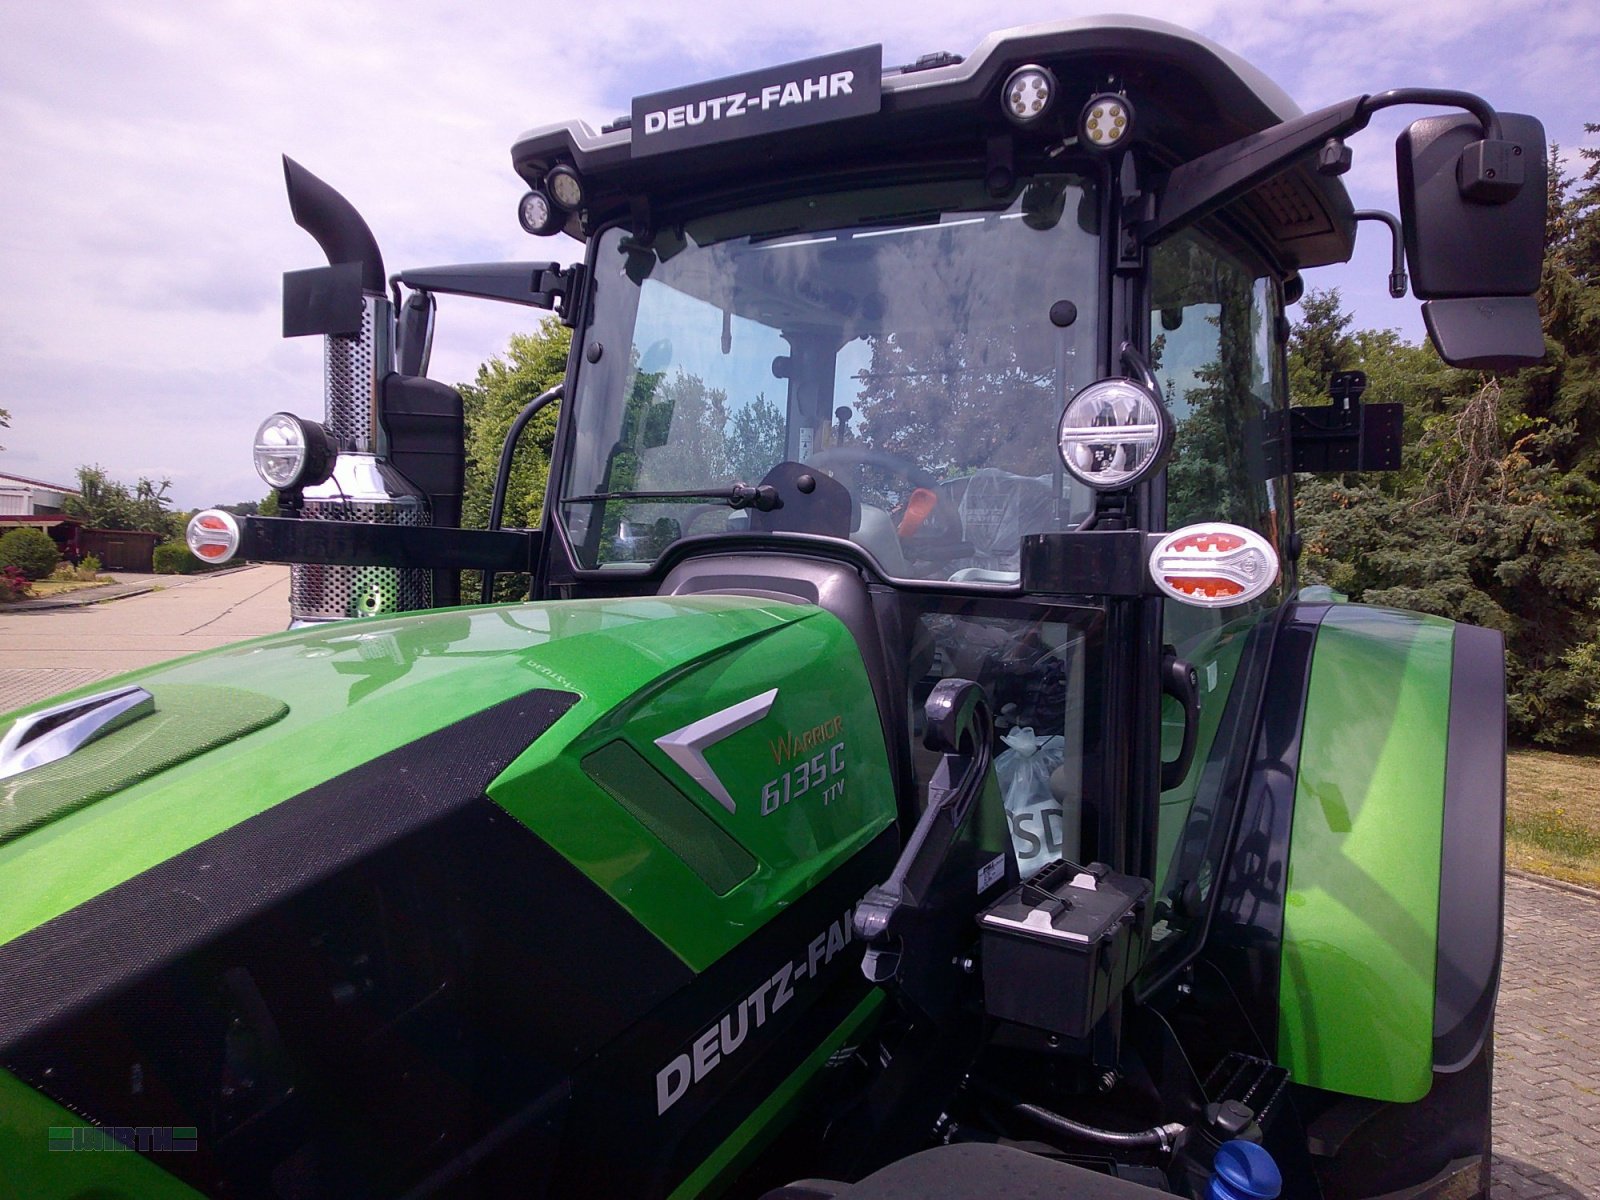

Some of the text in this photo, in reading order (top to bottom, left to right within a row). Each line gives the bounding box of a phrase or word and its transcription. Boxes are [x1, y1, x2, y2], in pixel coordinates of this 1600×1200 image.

[644, 70, 855, 135] DEUTZ-FAHR
[768, 715, 843, 766] WARRIOR
[822, 778, 845, 806] TTV
